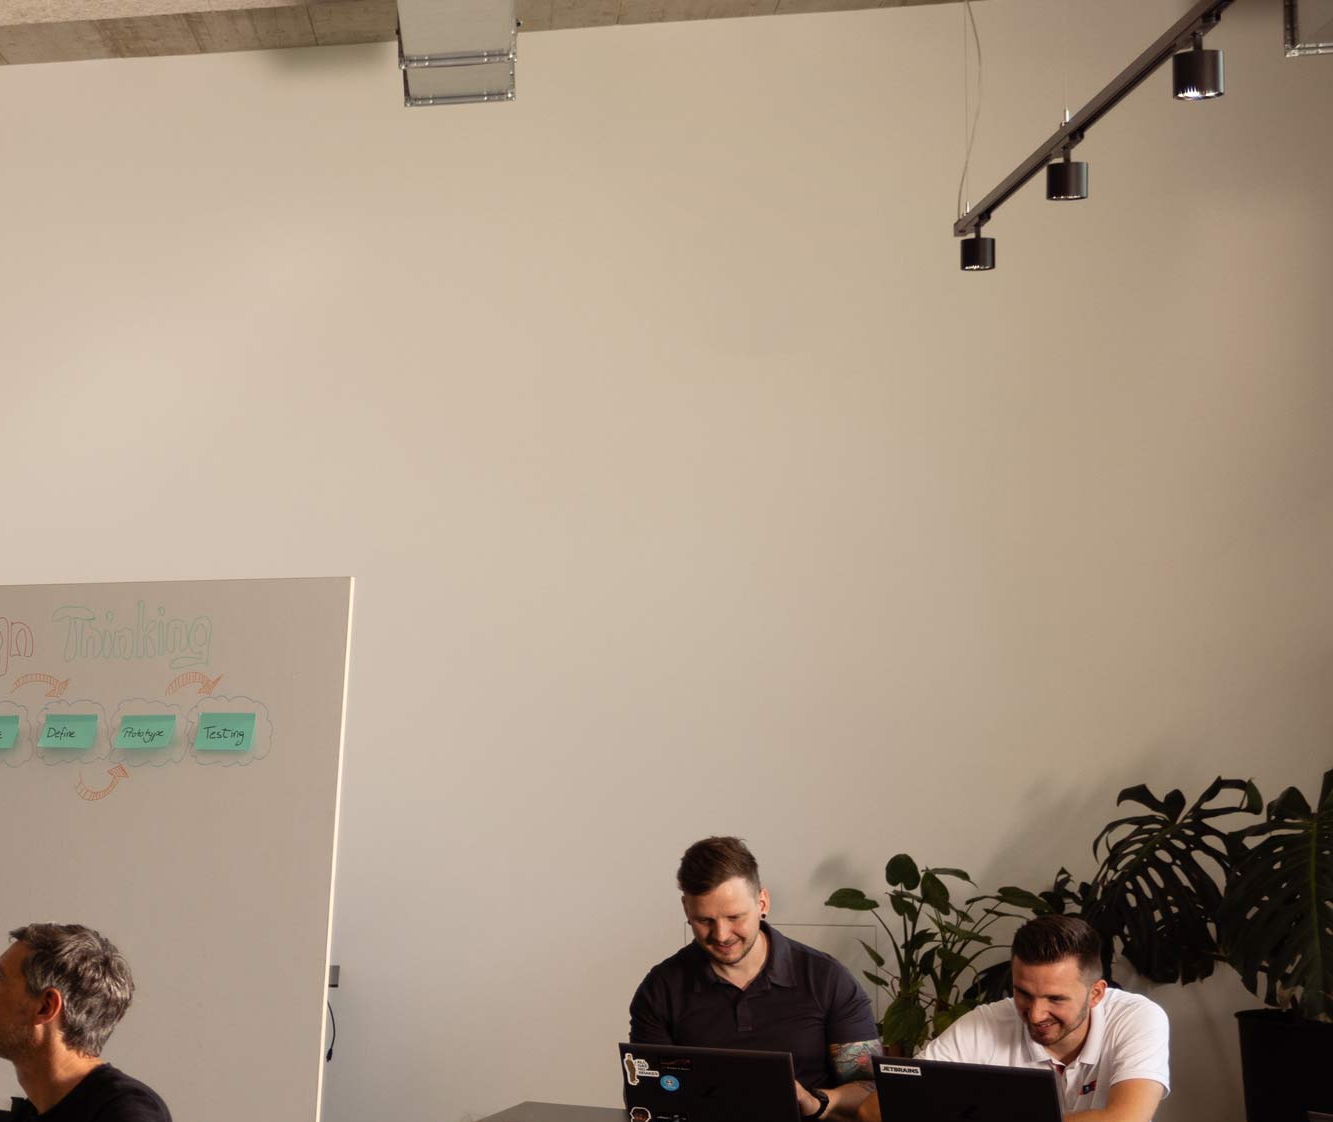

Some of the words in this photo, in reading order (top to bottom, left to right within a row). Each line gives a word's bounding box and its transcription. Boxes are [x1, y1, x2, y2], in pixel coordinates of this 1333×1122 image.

[52, 599, 213, 669] Thinking
[46, 727, 76, 739] Define
[122, 727, 164, 743] Prototype
[203, 725, 245, 747] Testing
[882, 1066, 919, 1074] JETBRAINS
